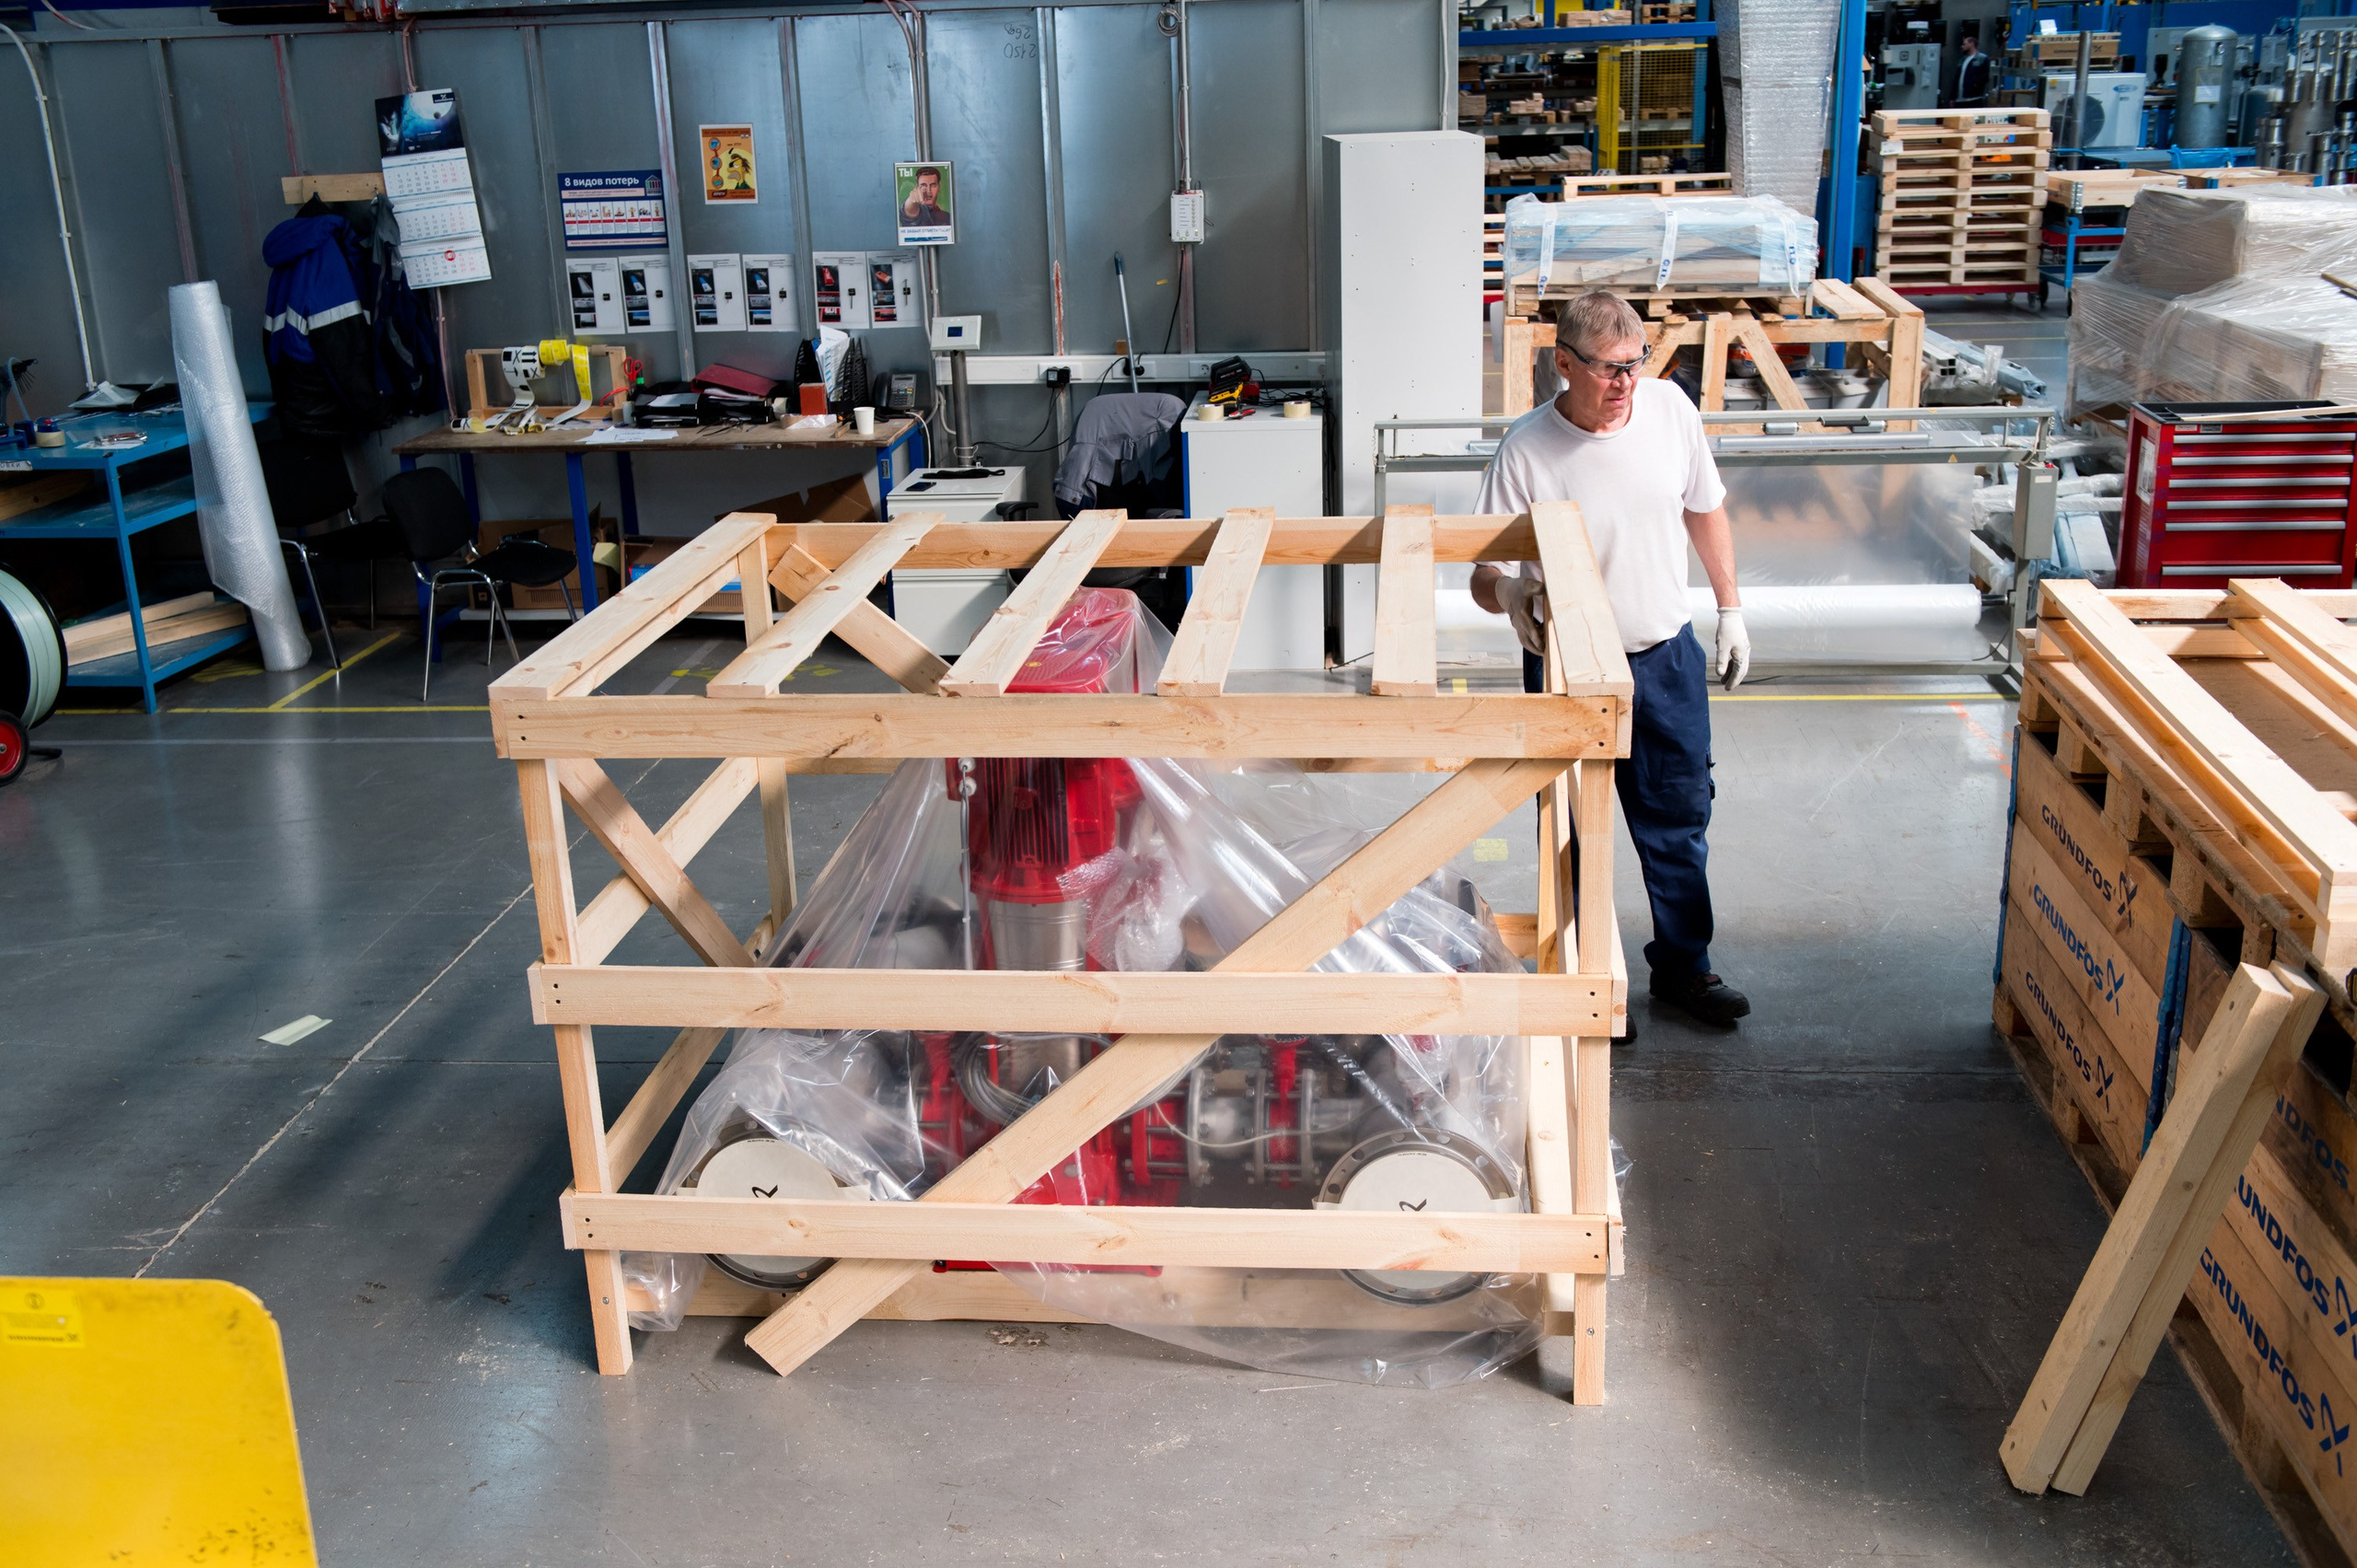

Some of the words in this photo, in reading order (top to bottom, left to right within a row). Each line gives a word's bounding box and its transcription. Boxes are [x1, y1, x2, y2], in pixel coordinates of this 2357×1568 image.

[1004, 42, 1037, 59] 2150
[564, 177, 571, 187] 8
[573, 178, 603, 188] видов
[605, 177, 639, 186] потерь
[899, 168, 912, 177] ТЫ
[2042, 804, 2112, 902] GRUNDFOS
[2033, 884, 2104, 991] GRUNDFOS
[2026, 971, 2092, 1083] GRUNDFOS
[2276, 1094, 2350, 1191] NDFOS
[2234, 1174, 2329, 1317] UNDFOS
[2200, 1247, 2316, 1431] GRUNDFOS
